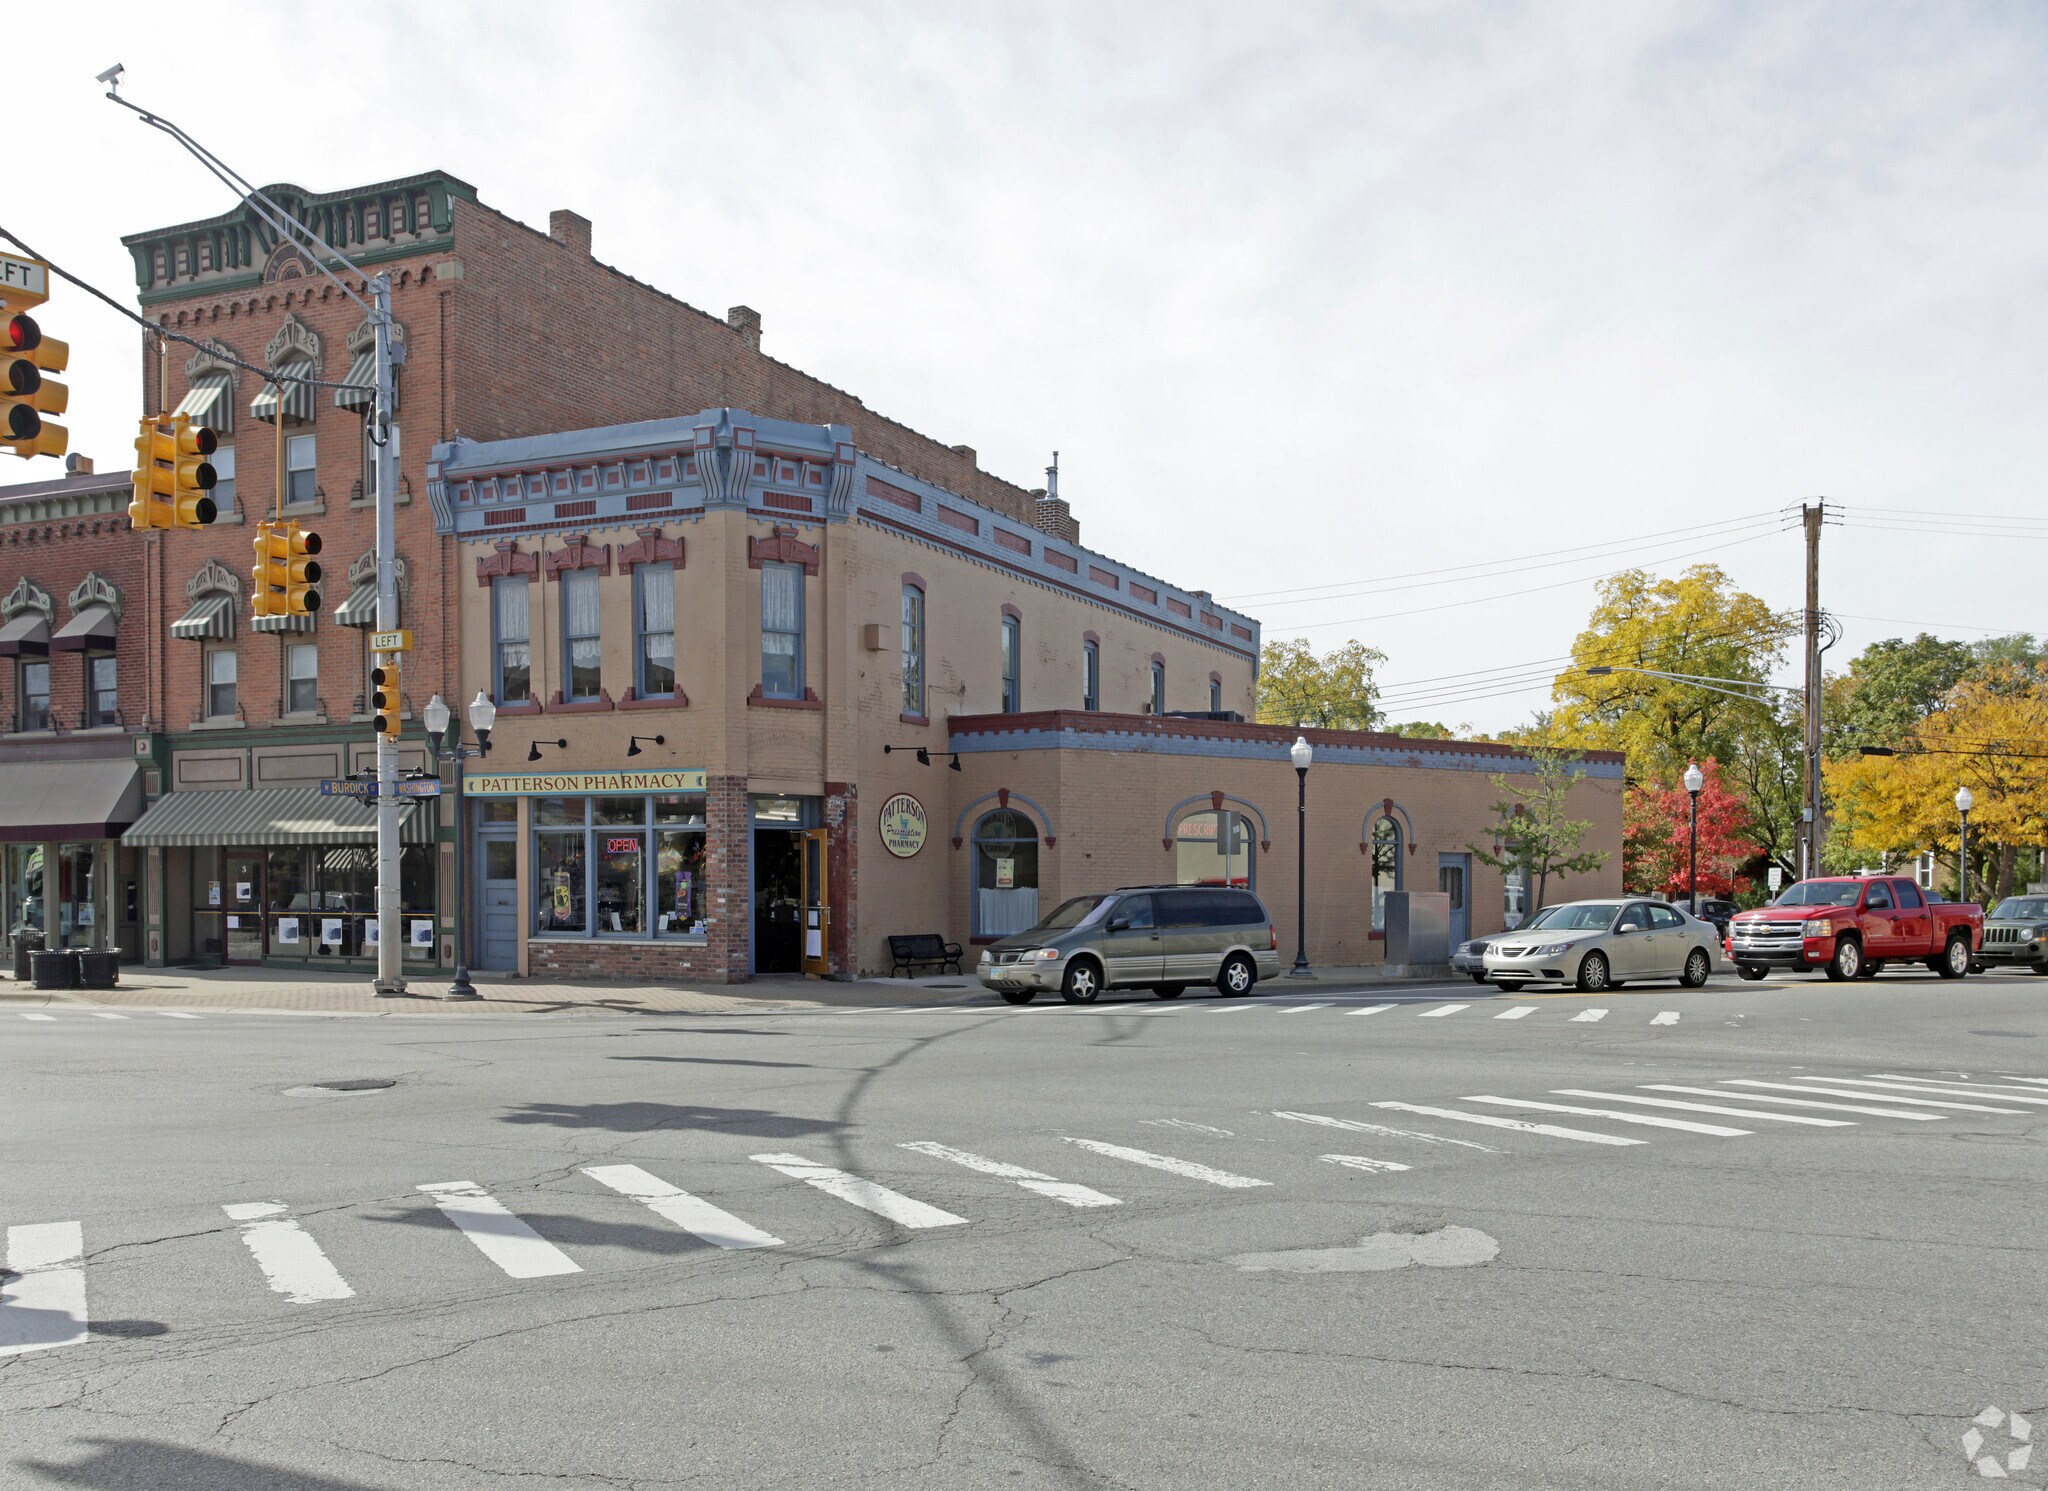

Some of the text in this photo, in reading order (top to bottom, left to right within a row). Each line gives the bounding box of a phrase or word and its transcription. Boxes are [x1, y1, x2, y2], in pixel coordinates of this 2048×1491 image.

[0, 260, 31, 287] FT
[375, 634, 398, 647] LEFT
[332, 782, 369, 794] BURDICK
[400, 782, 434, 793] WASHINGTON
[482, 774, 685, 792] PATTERSON PHARMACY
[883, 798, 925, 828] PATTERSON
[1178, 823, 1217, 836] PRESCRIP
[608, 839, 637, 852] OPEN
[888, 839, 920, 848] PHARMACY
